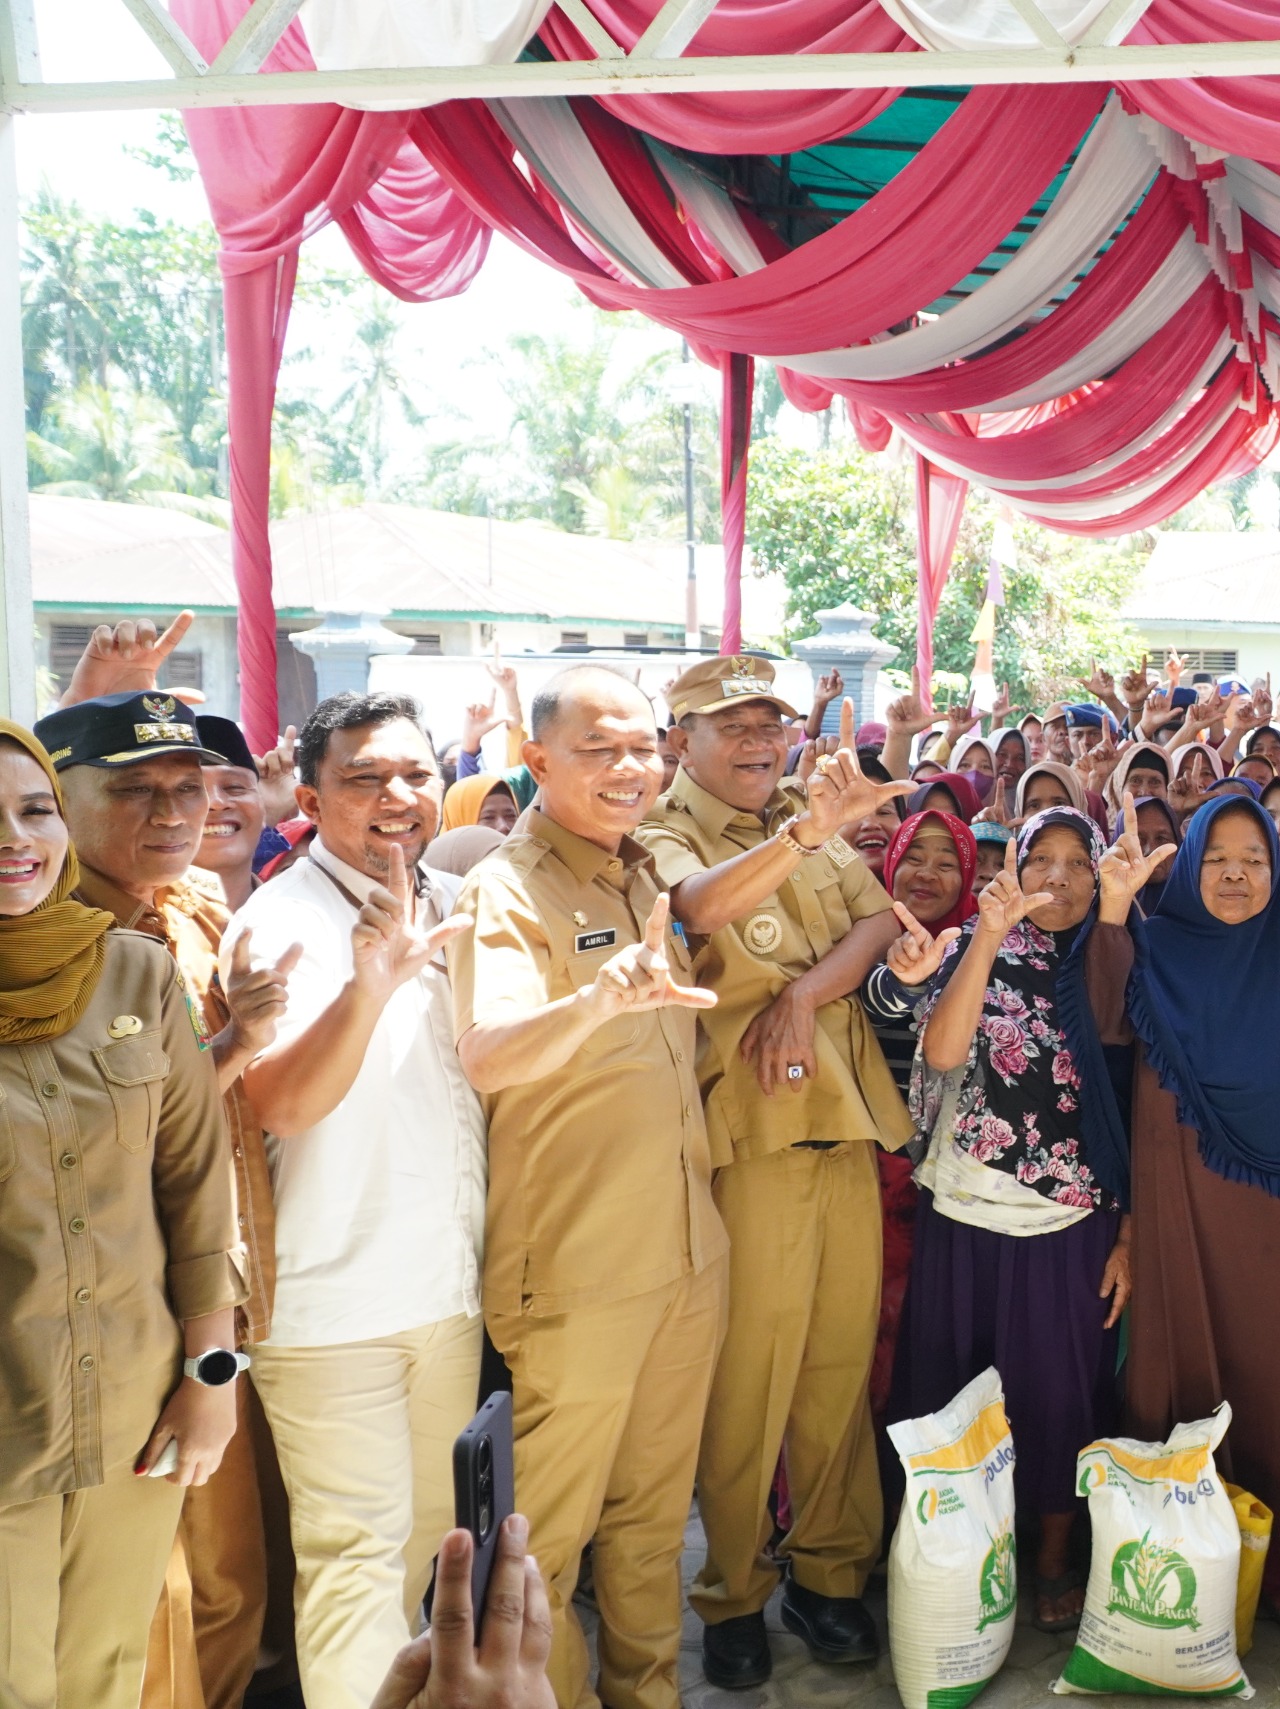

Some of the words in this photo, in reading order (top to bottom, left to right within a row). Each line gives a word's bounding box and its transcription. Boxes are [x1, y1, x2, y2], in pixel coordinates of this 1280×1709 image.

[585, 935, 608, 947] AMRIL
[985, 1446, 1016, 1482] bulo
[1108, 1585, 1152, 1616] BANTUAN
[1153, 1599, 1197, 1620] PANGAN
[1175, 1643, 1203, 1655] BERAS
